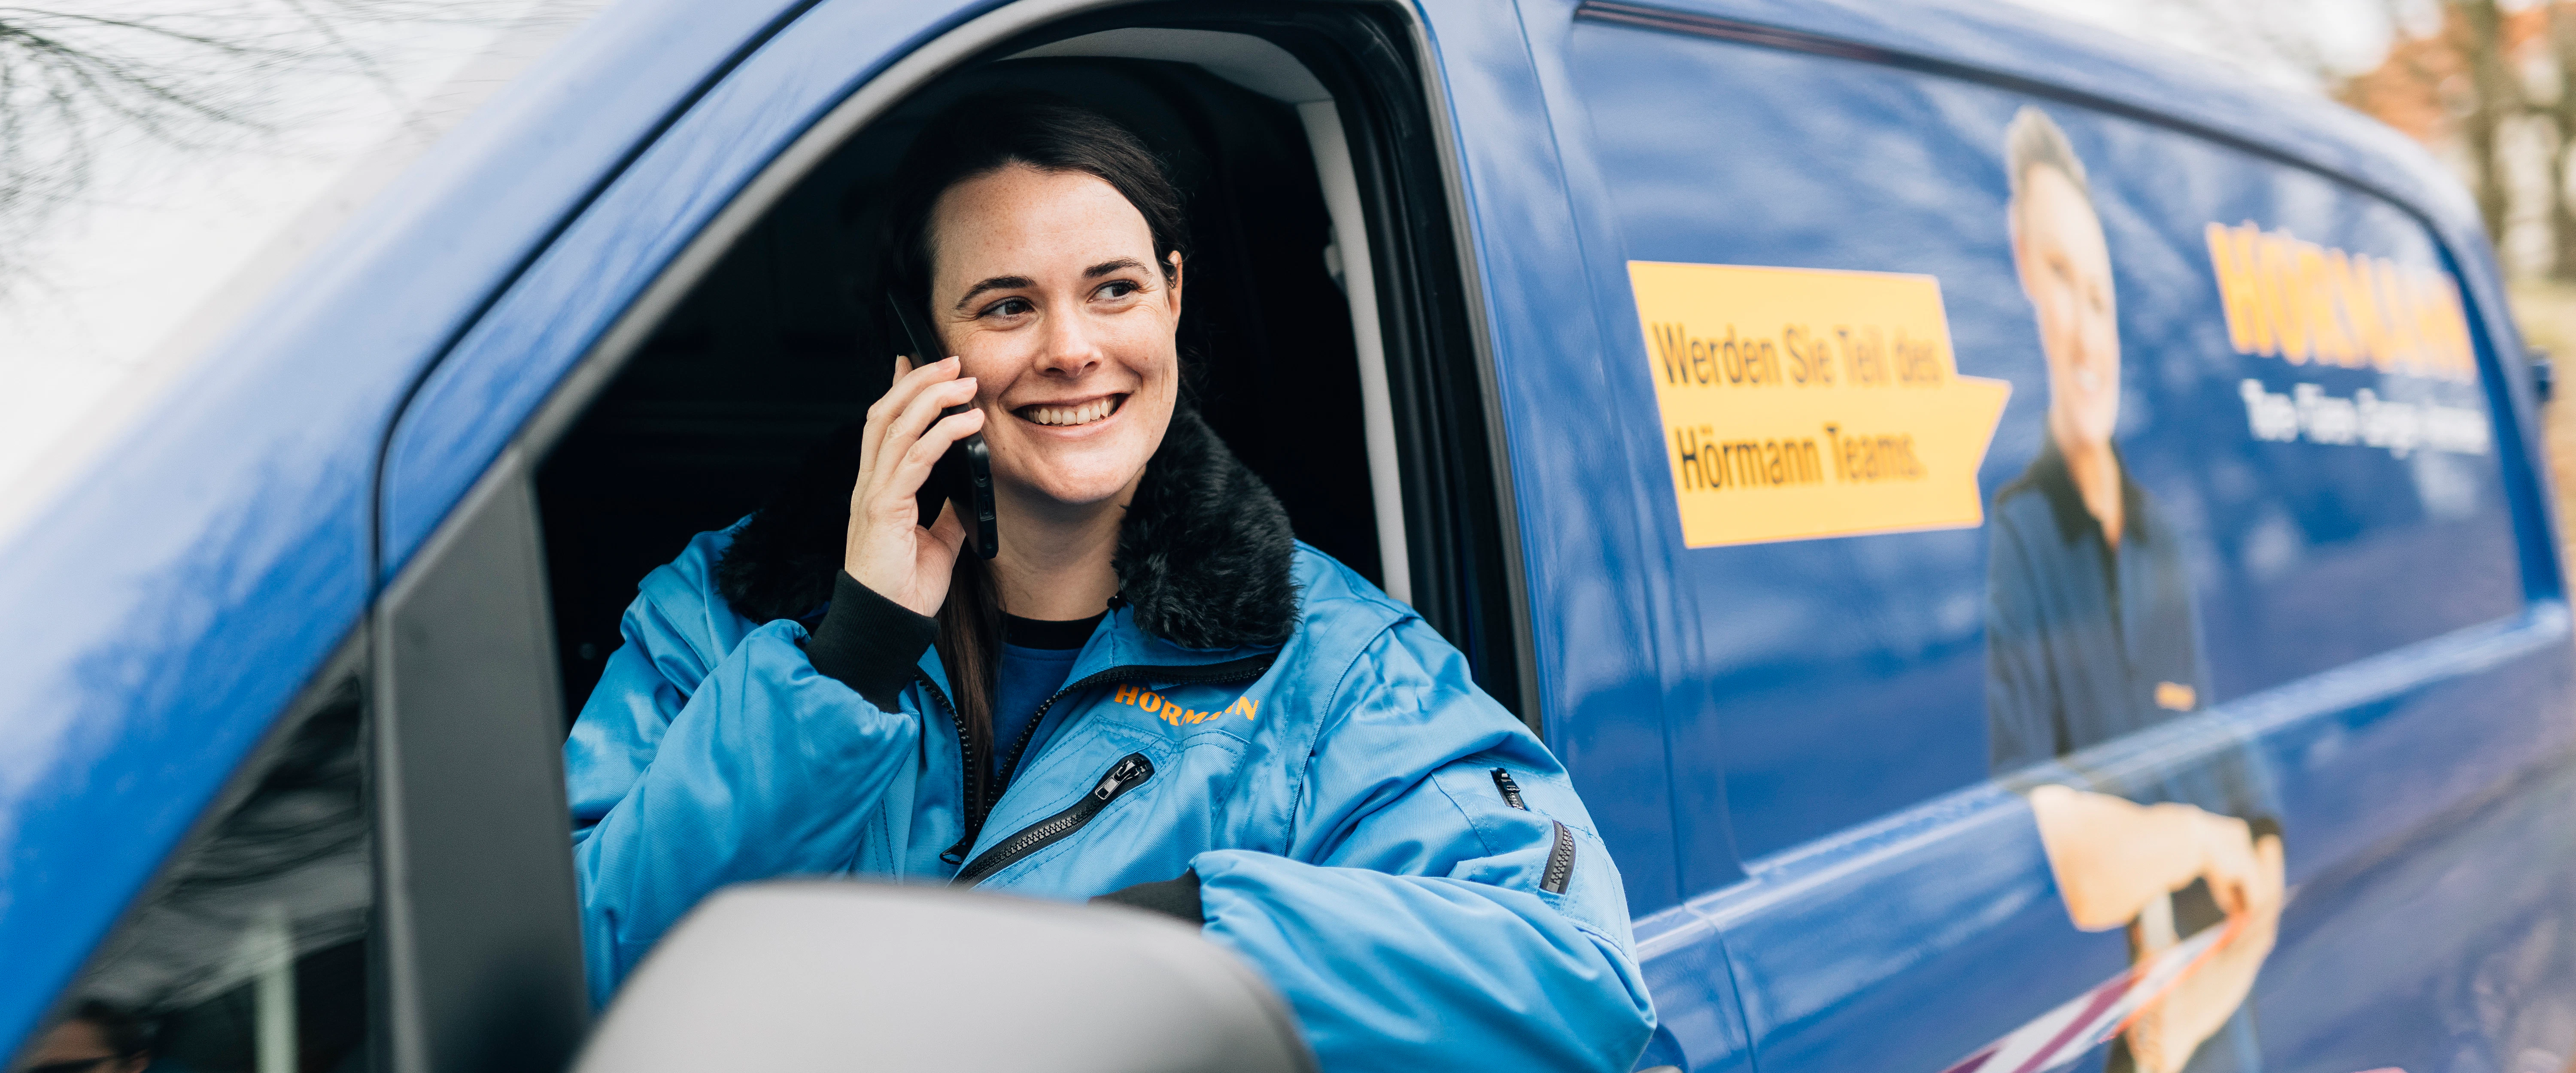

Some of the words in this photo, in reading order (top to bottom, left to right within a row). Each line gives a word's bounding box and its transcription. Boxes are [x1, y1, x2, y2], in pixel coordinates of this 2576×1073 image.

[1652, 323, 1782, 386] Werden
[1783, 325, 1834, 385] Sie
[1836, 325, 1884, 387] Teil
[1893, 328, 1944, 387] des
[1675, 425, 1823, 491] Hörmann
[1824, 422, 1927, 481] Teams.
